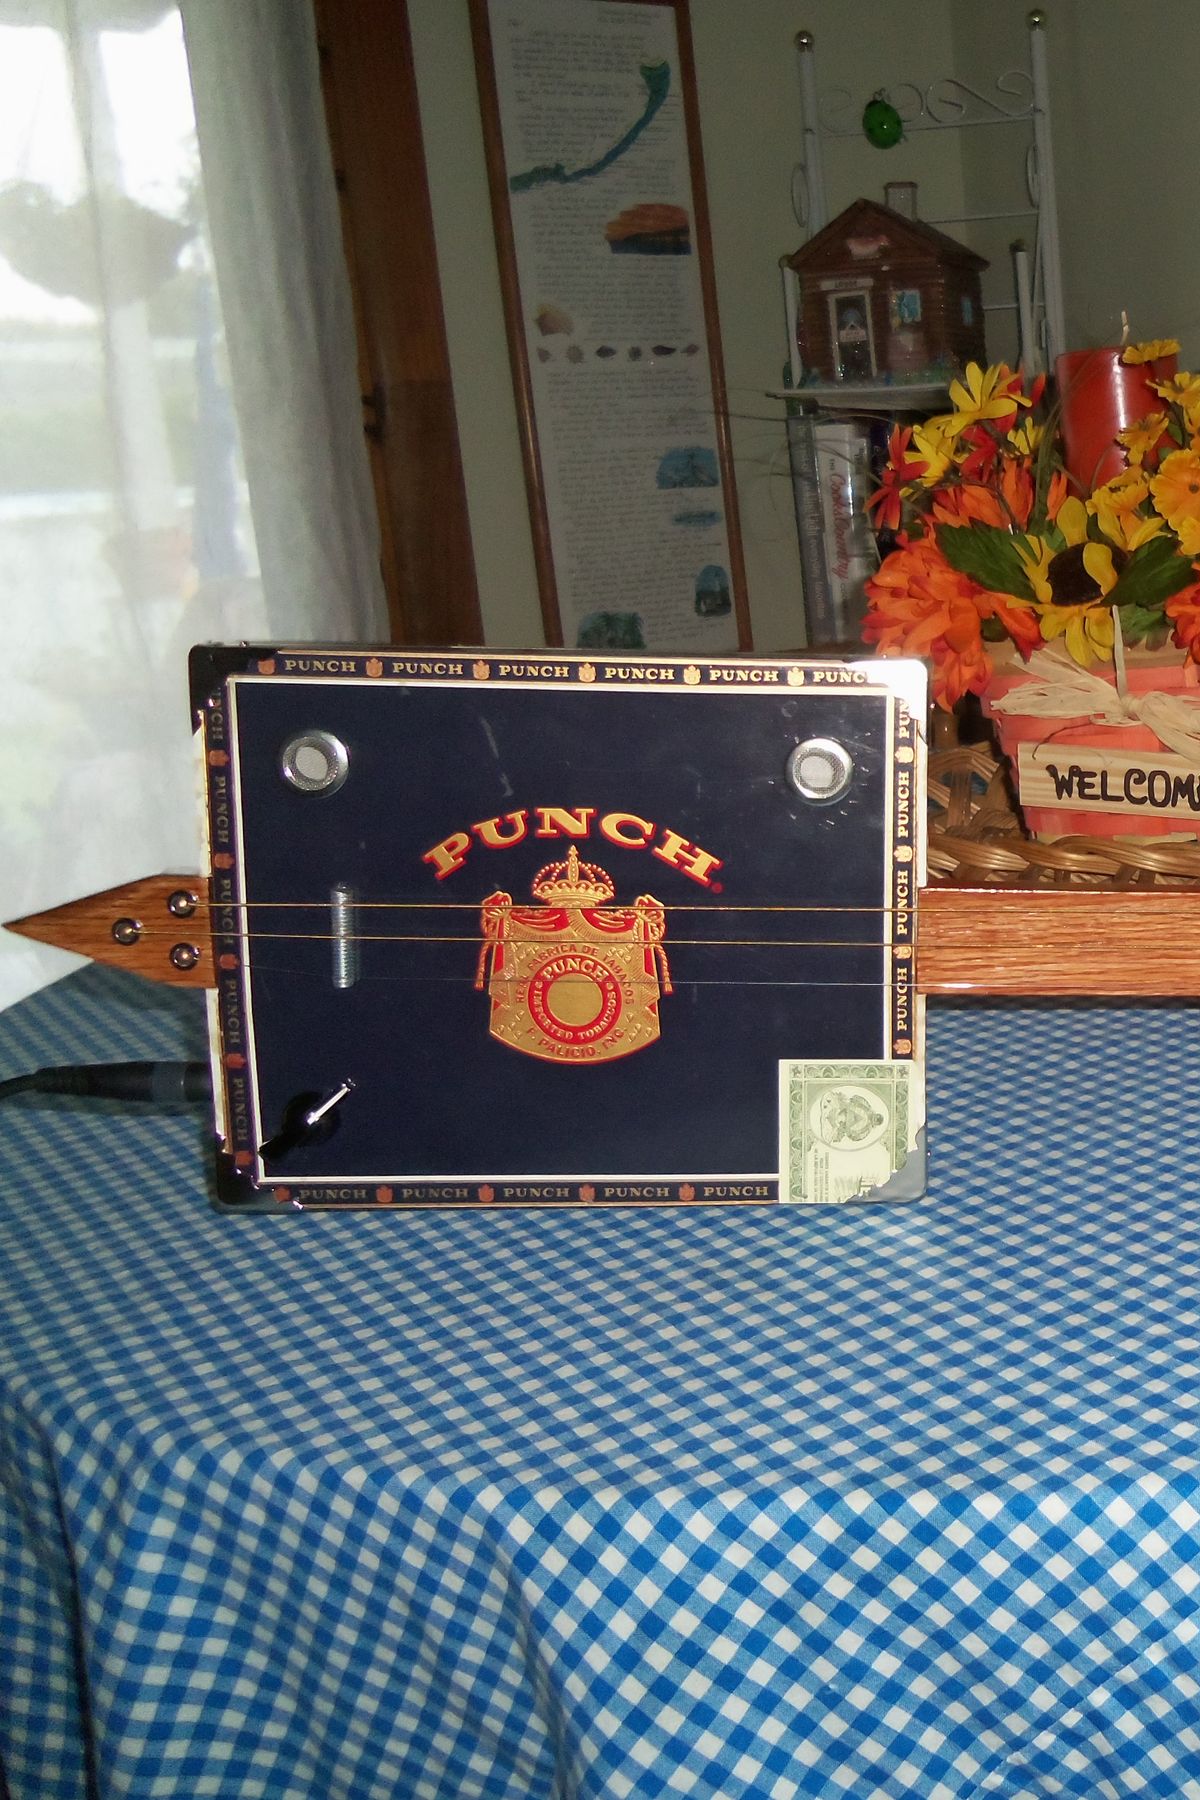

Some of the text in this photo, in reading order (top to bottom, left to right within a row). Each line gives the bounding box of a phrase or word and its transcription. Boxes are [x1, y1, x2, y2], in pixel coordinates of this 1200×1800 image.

[284, 658, 867, 684] PUNCH PUNCH PUNCH PUNCH PUNCH PUNC
[216, 776, 229, 845] PUNCH
[421, 807, 723, 889] PUNCH
[897, 701, 911, 1032] PUNCH PUNCH PUNCH PUN
[220, 877, 234, 946] PUNCH
[528, 943, 577, 971] FABRICA
[582, 944, 598, 956] DE
[603, 956, 634, 1005] TABACOS
[541, 957, 609, 981] PUNCH
[226, 978, 240, 1046] PUNCH
[577, 991, 617, 1040] TOBACCOS
[233, 1077, 248, 1143] PUNCH
[299, 1185, 769, 1201] PUNCH PUNCH PUNCH PUNCH PUNCH
